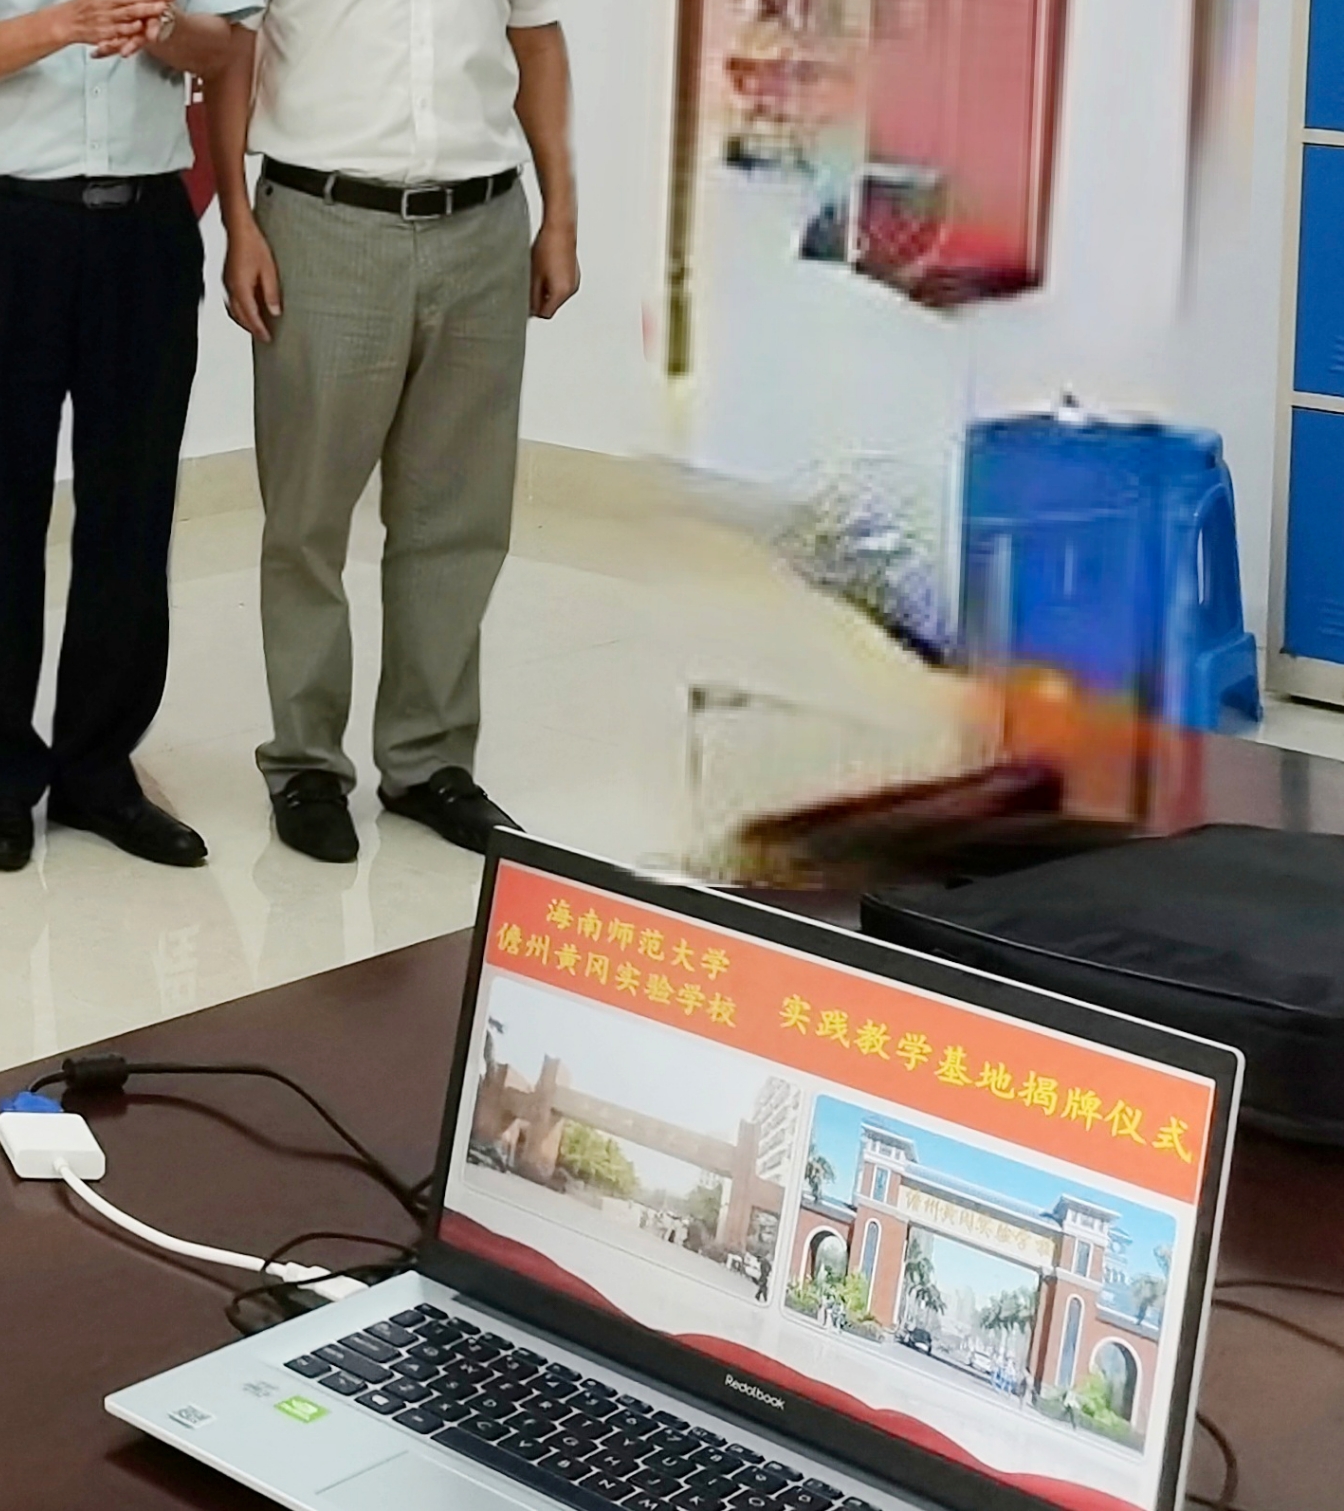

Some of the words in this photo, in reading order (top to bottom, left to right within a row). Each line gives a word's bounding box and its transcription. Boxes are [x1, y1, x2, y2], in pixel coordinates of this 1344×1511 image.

[545, 897, 731, 981] 海南师范大学
[497, 922, 737, 1029] 儋州黄冈实验学校
[777, 992, 1193, 1164] 实践教学基地揭牌仪式
